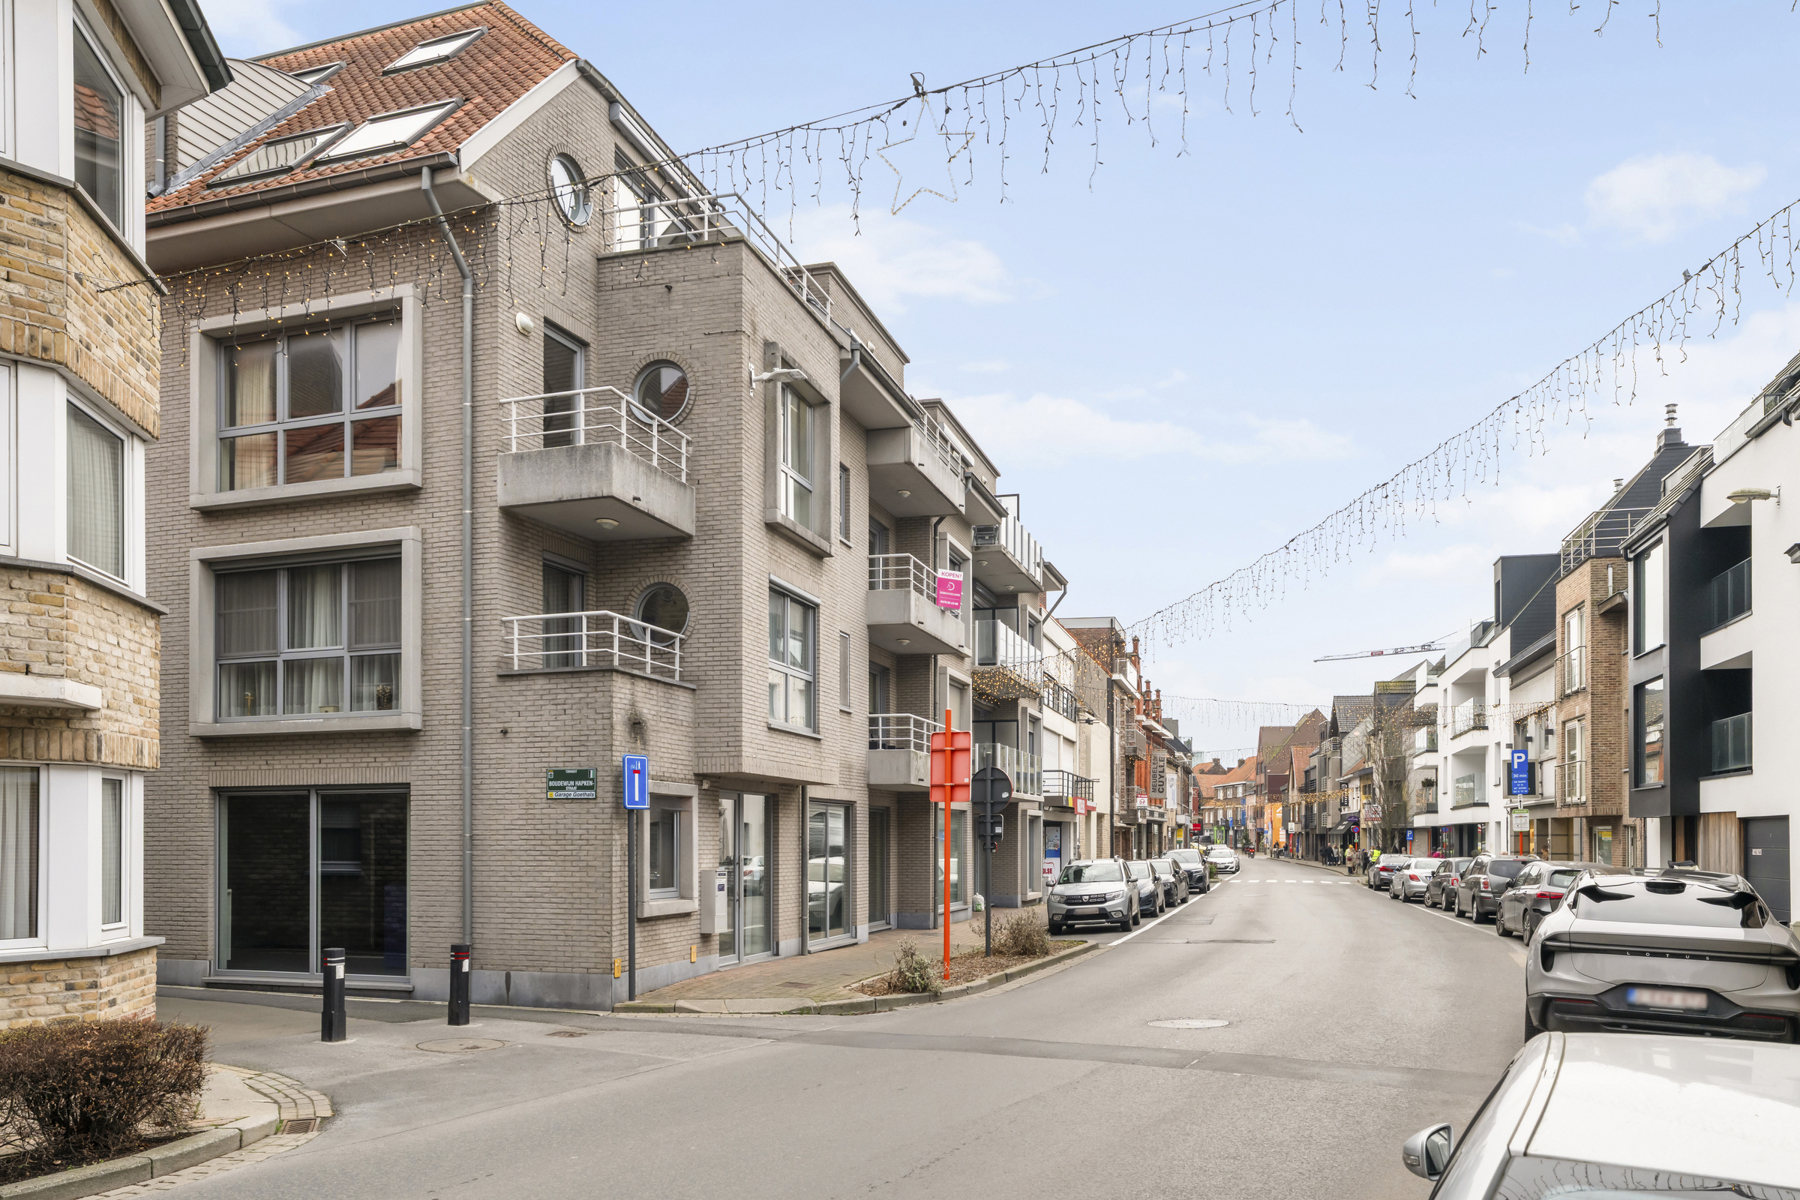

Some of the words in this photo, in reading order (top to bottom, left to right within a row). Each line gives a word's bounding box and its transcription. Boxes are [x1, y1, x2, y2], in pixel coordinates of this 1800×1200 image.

[941, 571, 962, 579] KOPEN?
[1514, 753, 1526, 769] P
[1407, 830, 1413, 838] P
[1626, 951, 1709, 960] LOTUS
